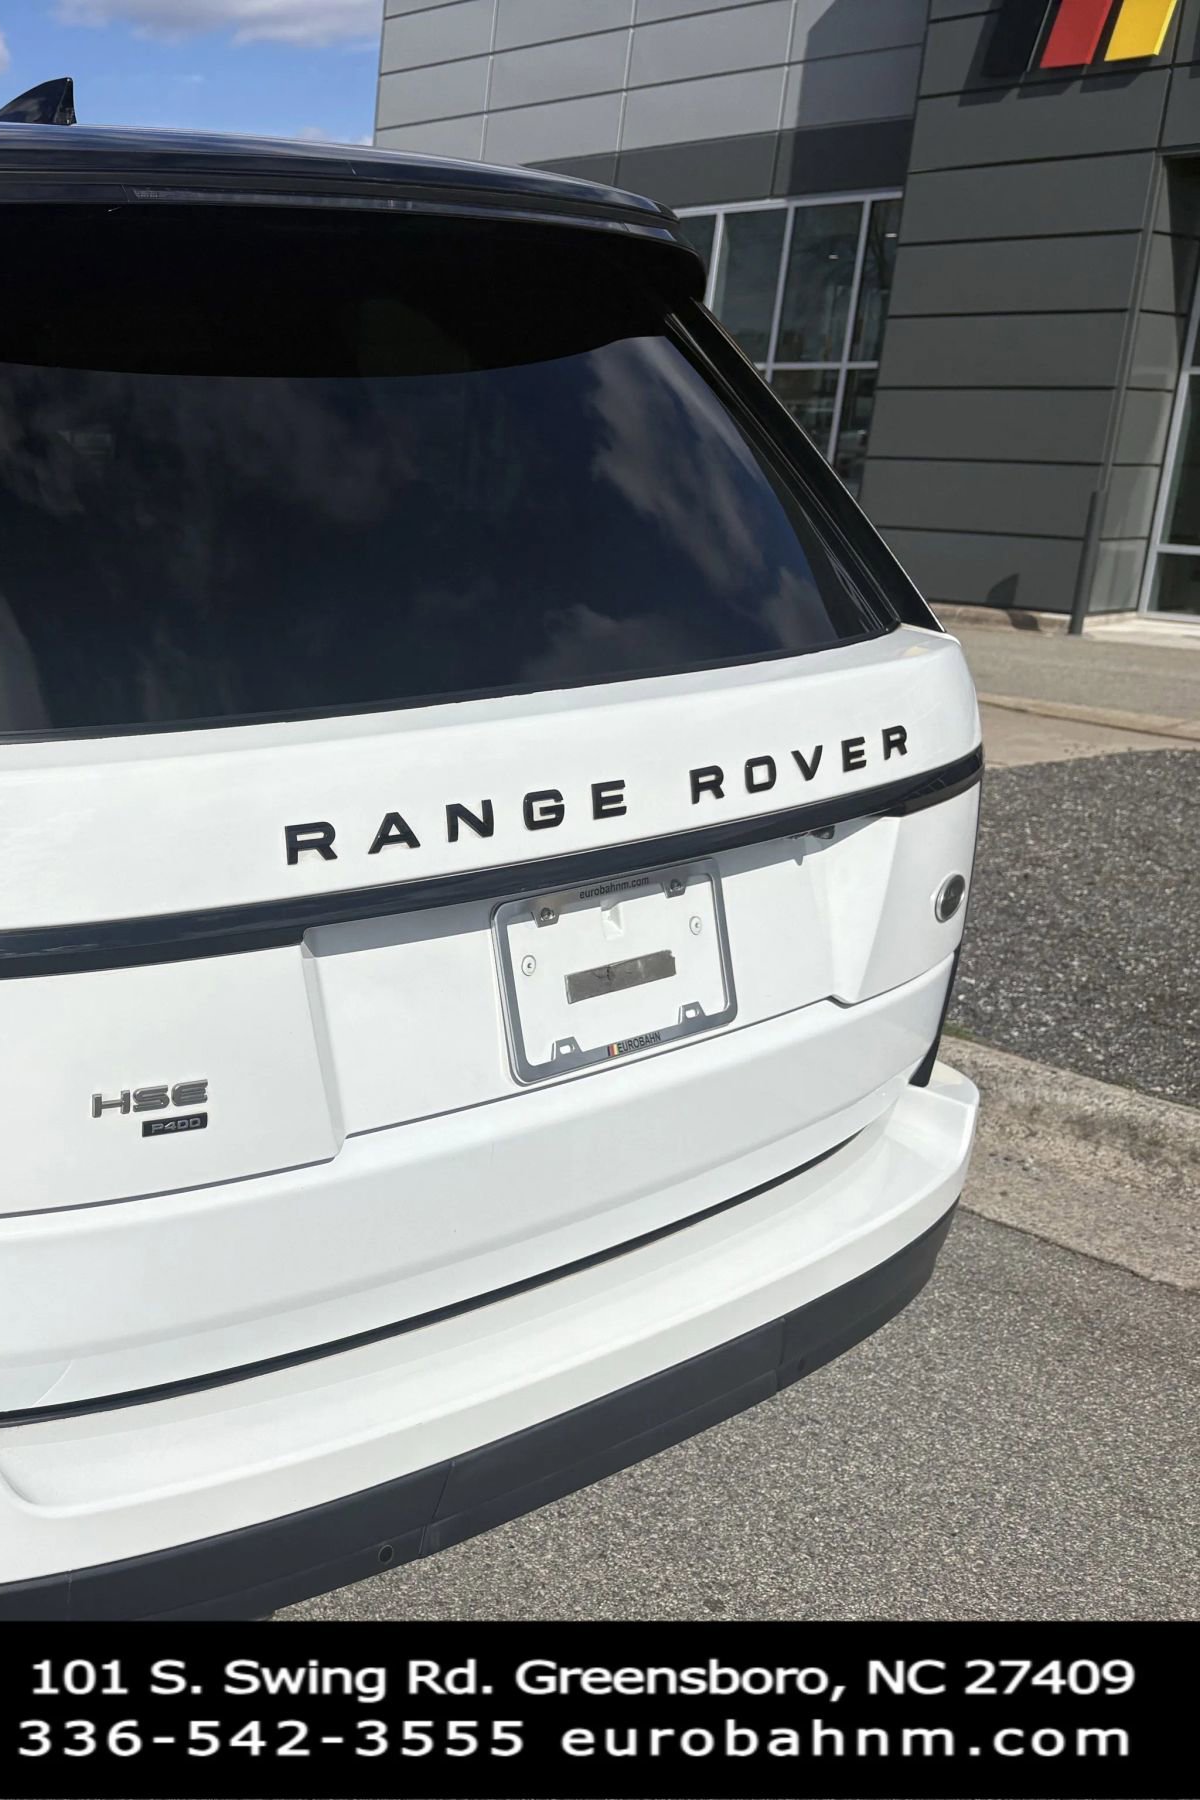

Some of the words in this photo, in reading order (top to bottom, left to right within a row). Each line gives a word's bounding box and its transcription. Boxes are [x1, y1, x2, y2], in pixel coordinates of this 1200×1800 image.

[285, 779, 628, 865] RANGE
[689, 725, 910, 805] ROVER
[580, 876, 649, 899] eurobahnm.com
[617, 1031, 661, 1053] EUROBAHN
[91, 1079, 209, 1118] HSE
[151, 1116, 202, 1134] P400
